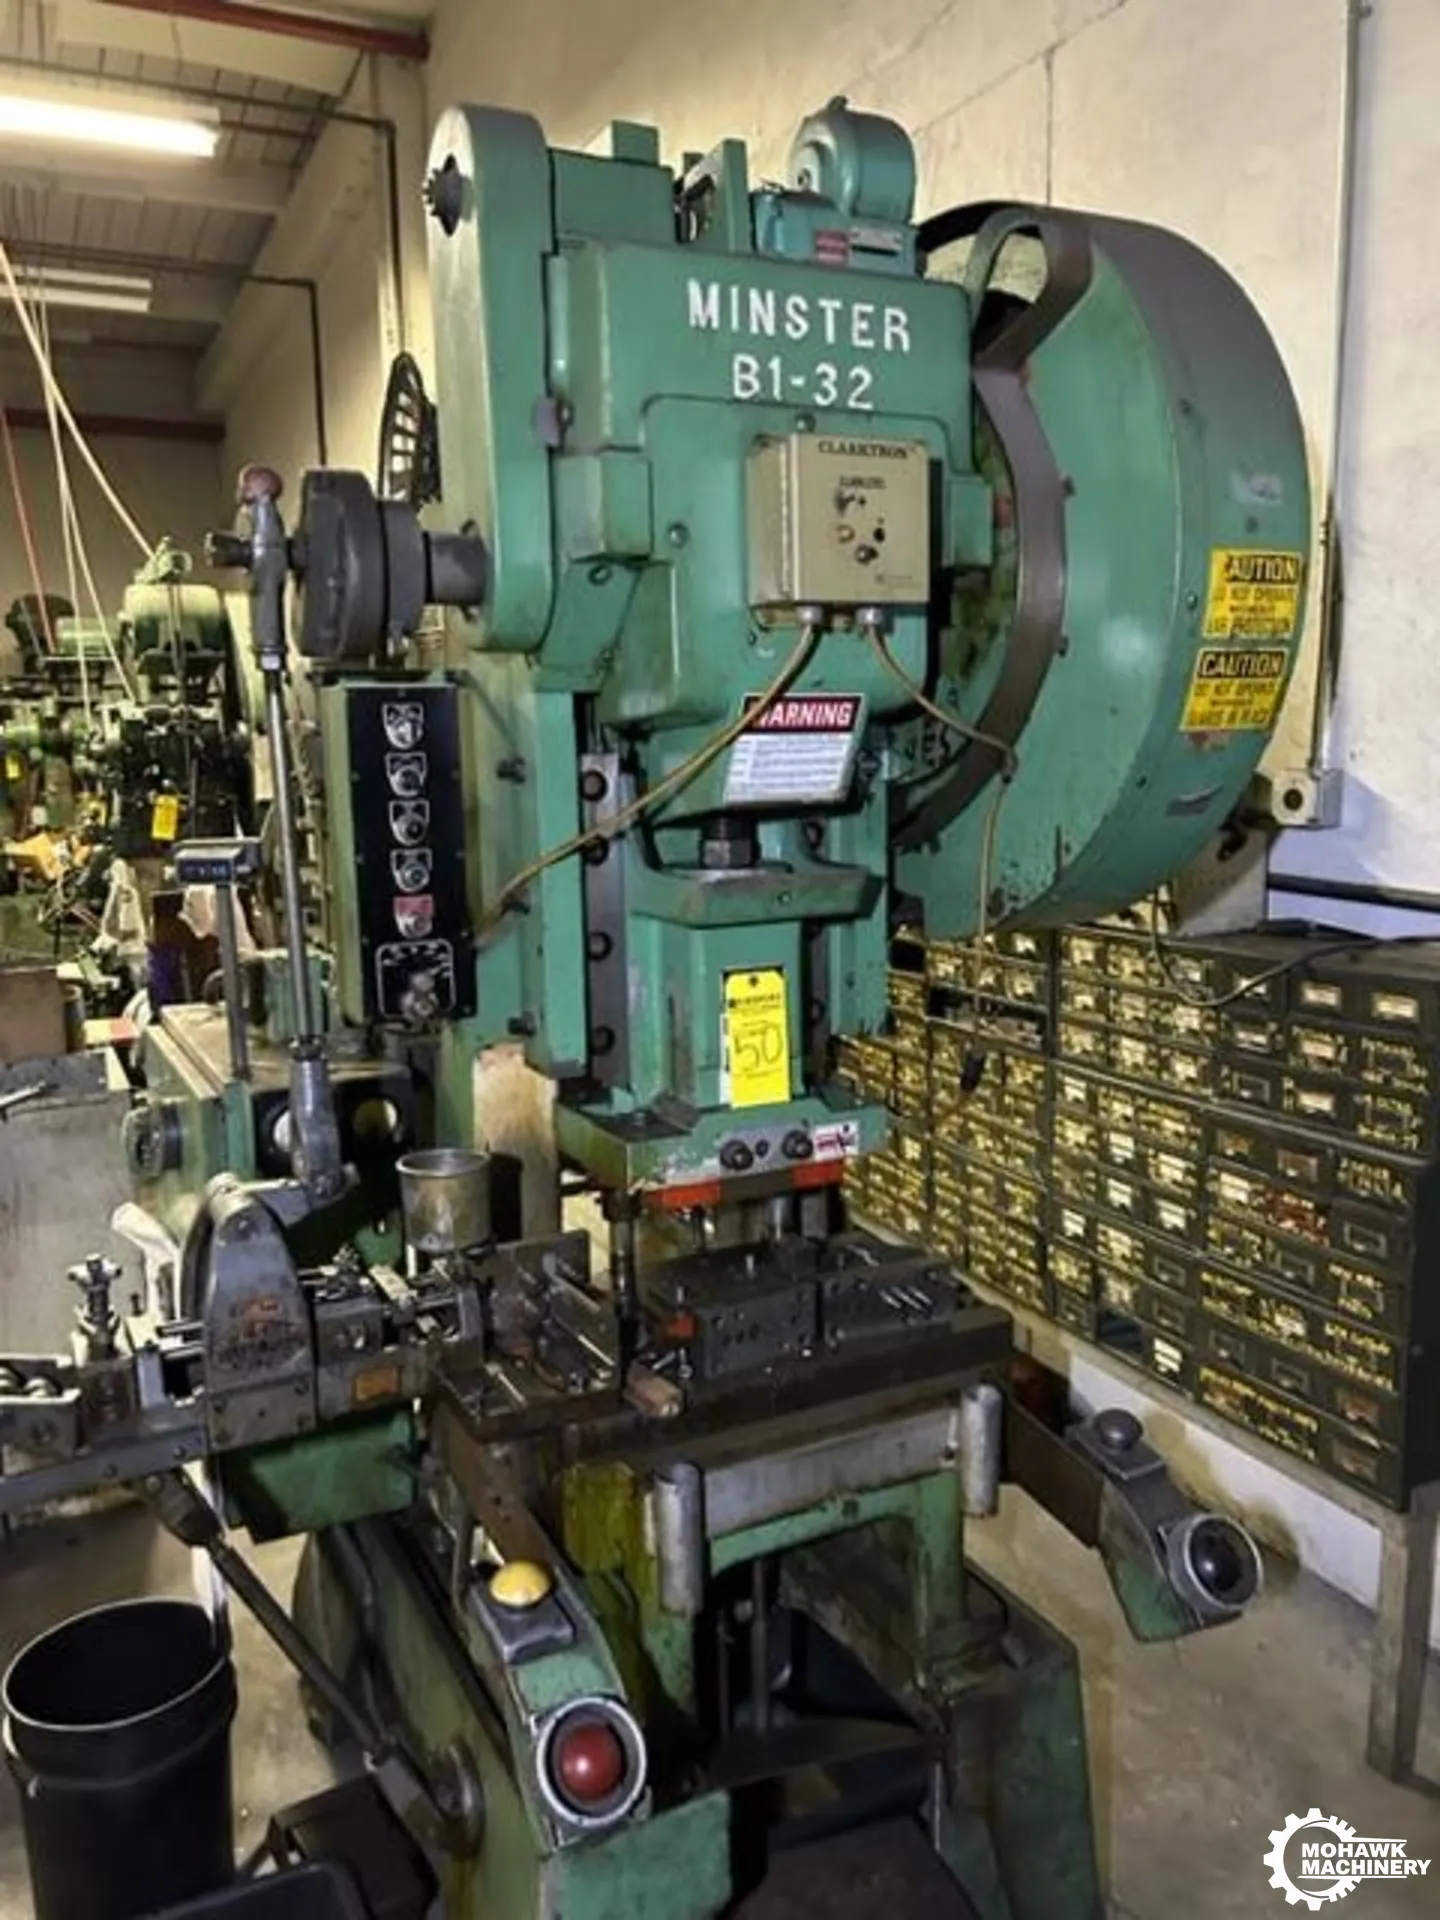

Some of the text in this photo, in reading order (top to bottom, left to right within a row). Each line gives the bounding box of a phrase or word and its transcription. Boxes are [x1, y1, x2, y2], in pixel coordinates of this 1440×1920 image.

[686, 277, 911, 353] MINSTER
[732, 354, 875, 410] B1-32
[1202, 653, 1281, 677] CAUTION
[732, 1020, 783, 1073] 50
